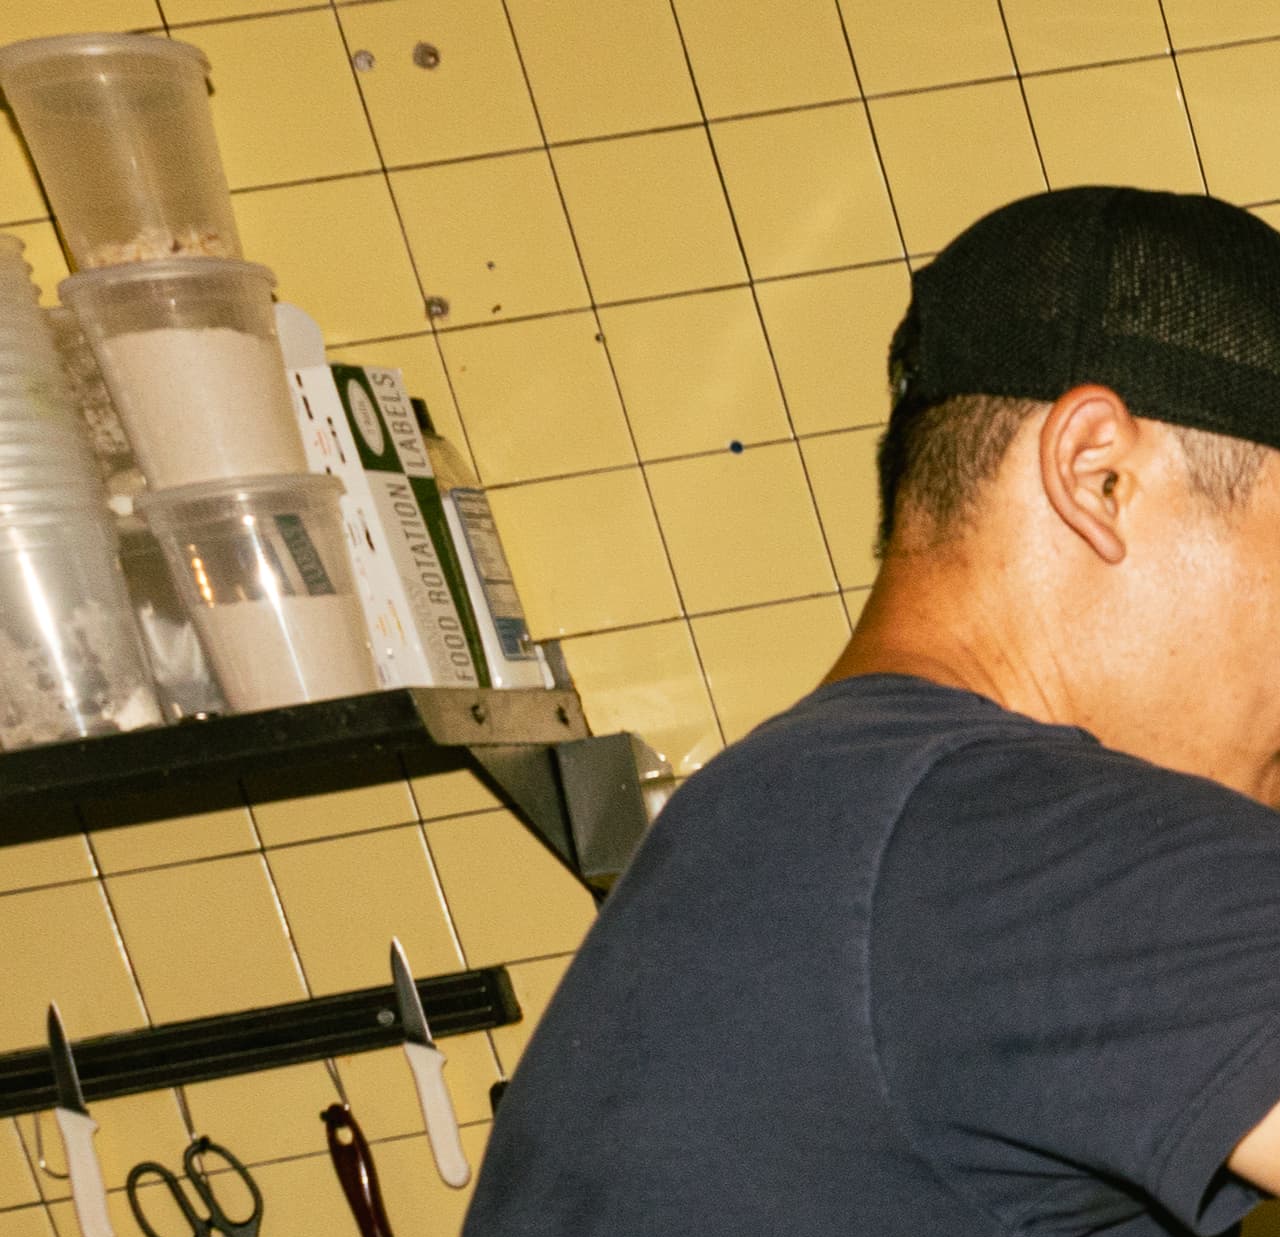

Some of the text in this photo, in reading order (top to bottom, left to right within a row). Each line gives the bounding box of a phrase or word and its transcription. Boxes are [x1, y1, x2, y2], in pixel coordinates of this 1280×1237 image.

[371, 373, 427, 469] LABELS
[387, 482, 450, 606] ROTATION
[438, 615, 475, 682] FOOD
